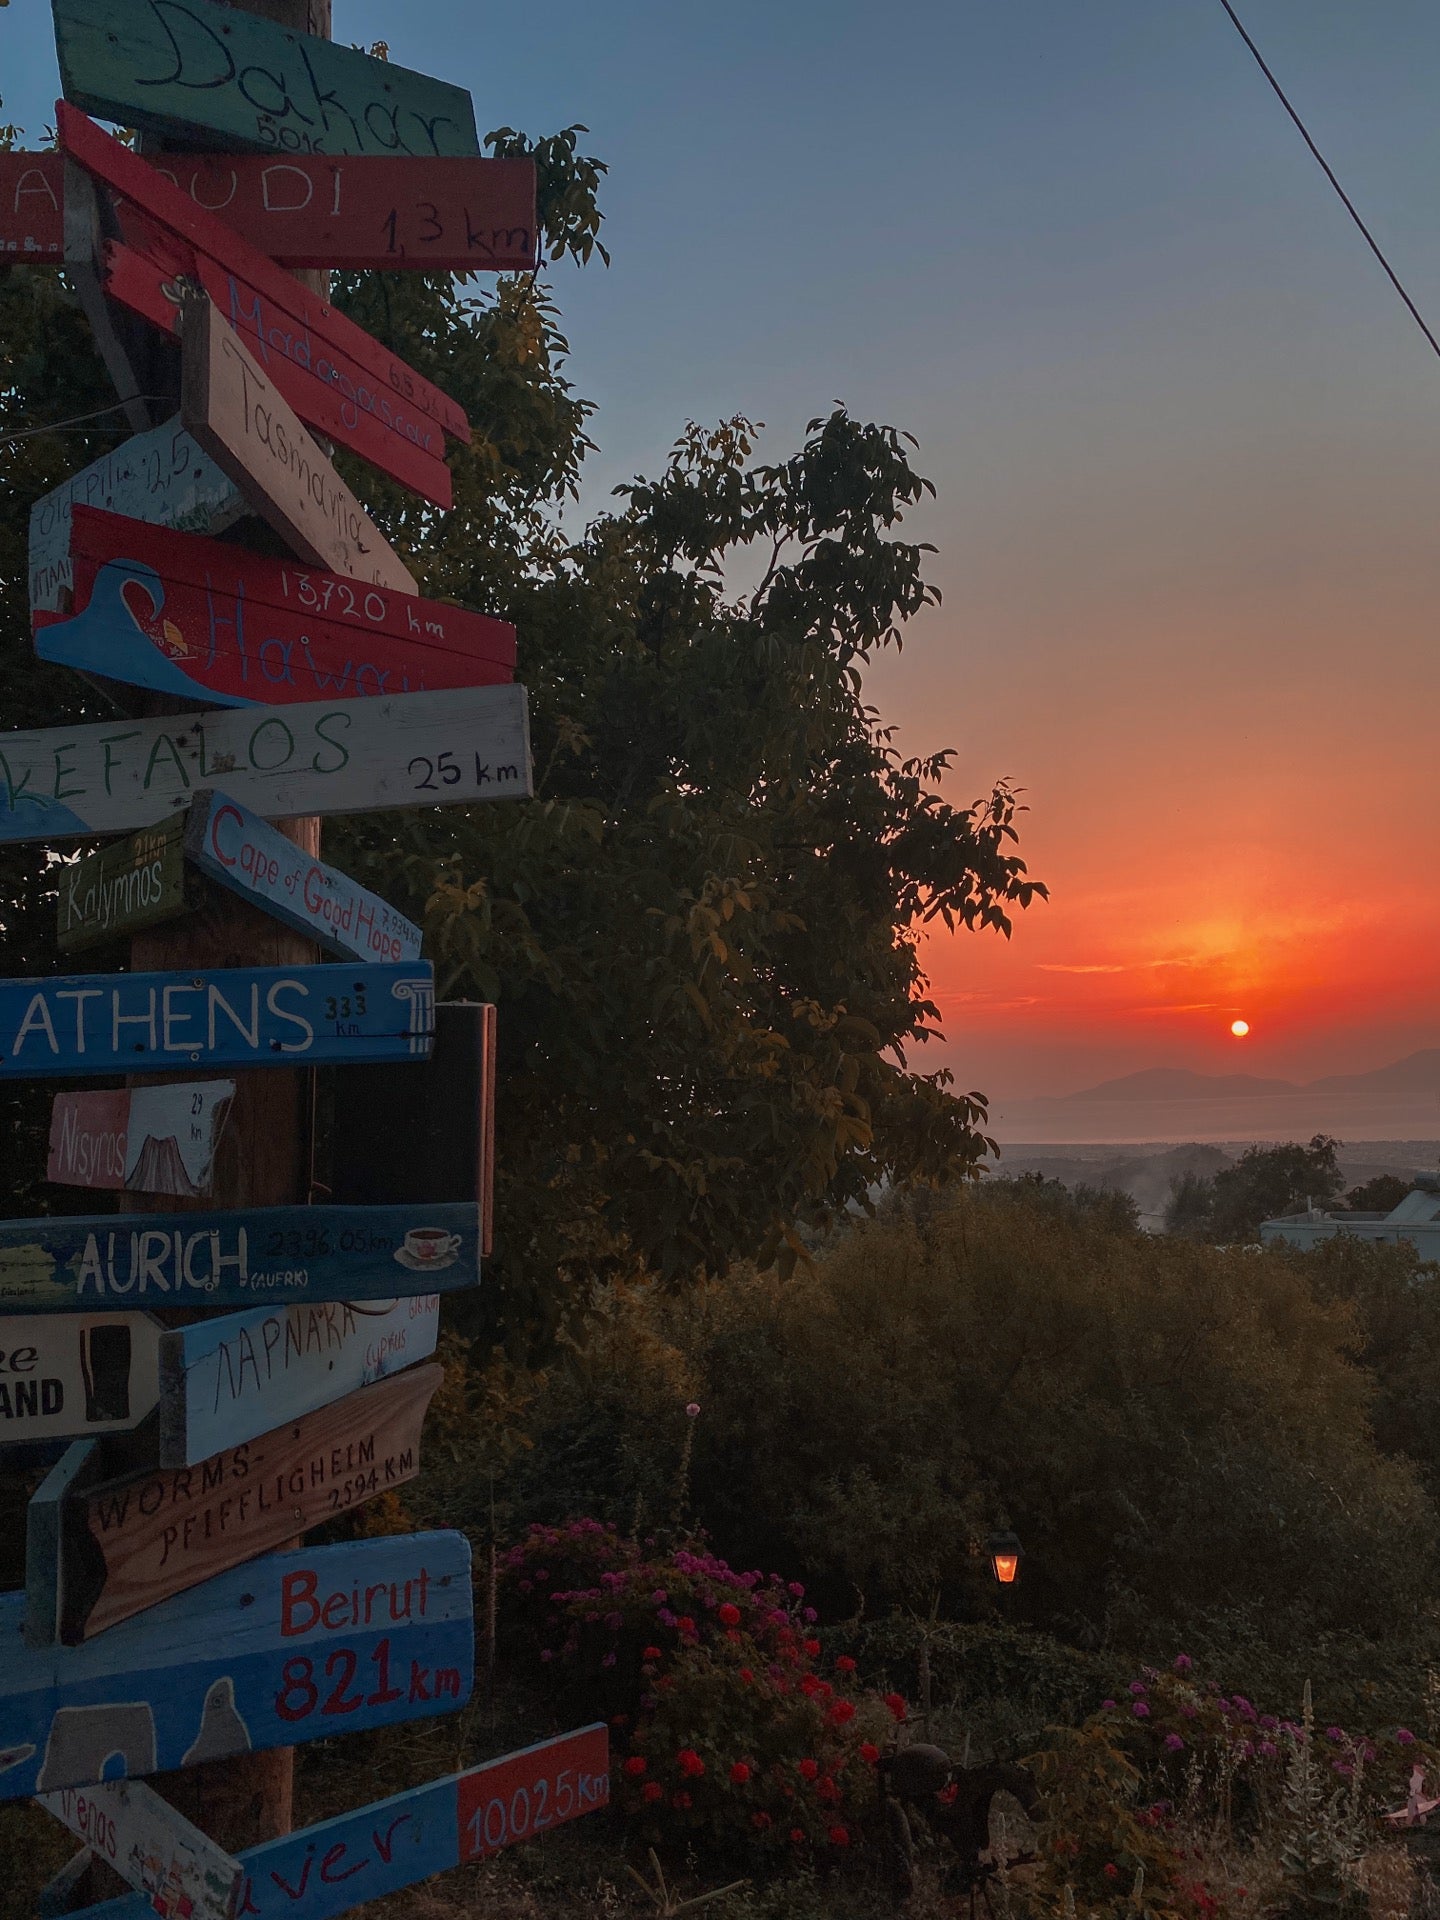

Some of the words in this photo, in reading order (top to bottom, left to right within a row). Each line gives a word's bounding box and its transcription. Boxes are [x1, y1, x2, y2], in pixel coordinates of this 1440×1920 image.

[133, 0, 452, 157] Dakar
[464, 207, 531, 257] km
[228, 275, 432, 450] Madagascar
[222, 337, 364, 546] Tasmania
[405, 604, 446, 640] km
[0, 712, 352, 812] KEFALOS
[408, 752, 462, 790] 25
[475, 752, 519, 786] km
[66, 860, 163, 930] Kalymnos
[211, 804, 279, 888] Cape
[284, 869, 301, 896] of
[303, 866, 353, 933] Good
[356, 899, 403, 963] Hope
[12, 979, 314, 1057] ATHENS
[324, 994, 366, 1020] 333
[335, 1020, 360, 1036] km
[190, 1125, 202, 1142] km
[191, 1092, 203, 1115] 29
[57, 1106, 125, 1189] Nisyros
[76, 1226, 248, 1295] AURICH
[99, 1444, 265, 1532] WORMS-
[160, 1434, 375, 1567] PFIFFLIGHEIM
[385, 1447, 412, 1484] KM
[280, 1567, 431, 1637] Beirut
[274, 1638, 403, 1722] 821
[408, 1660, 461, 1706] km
